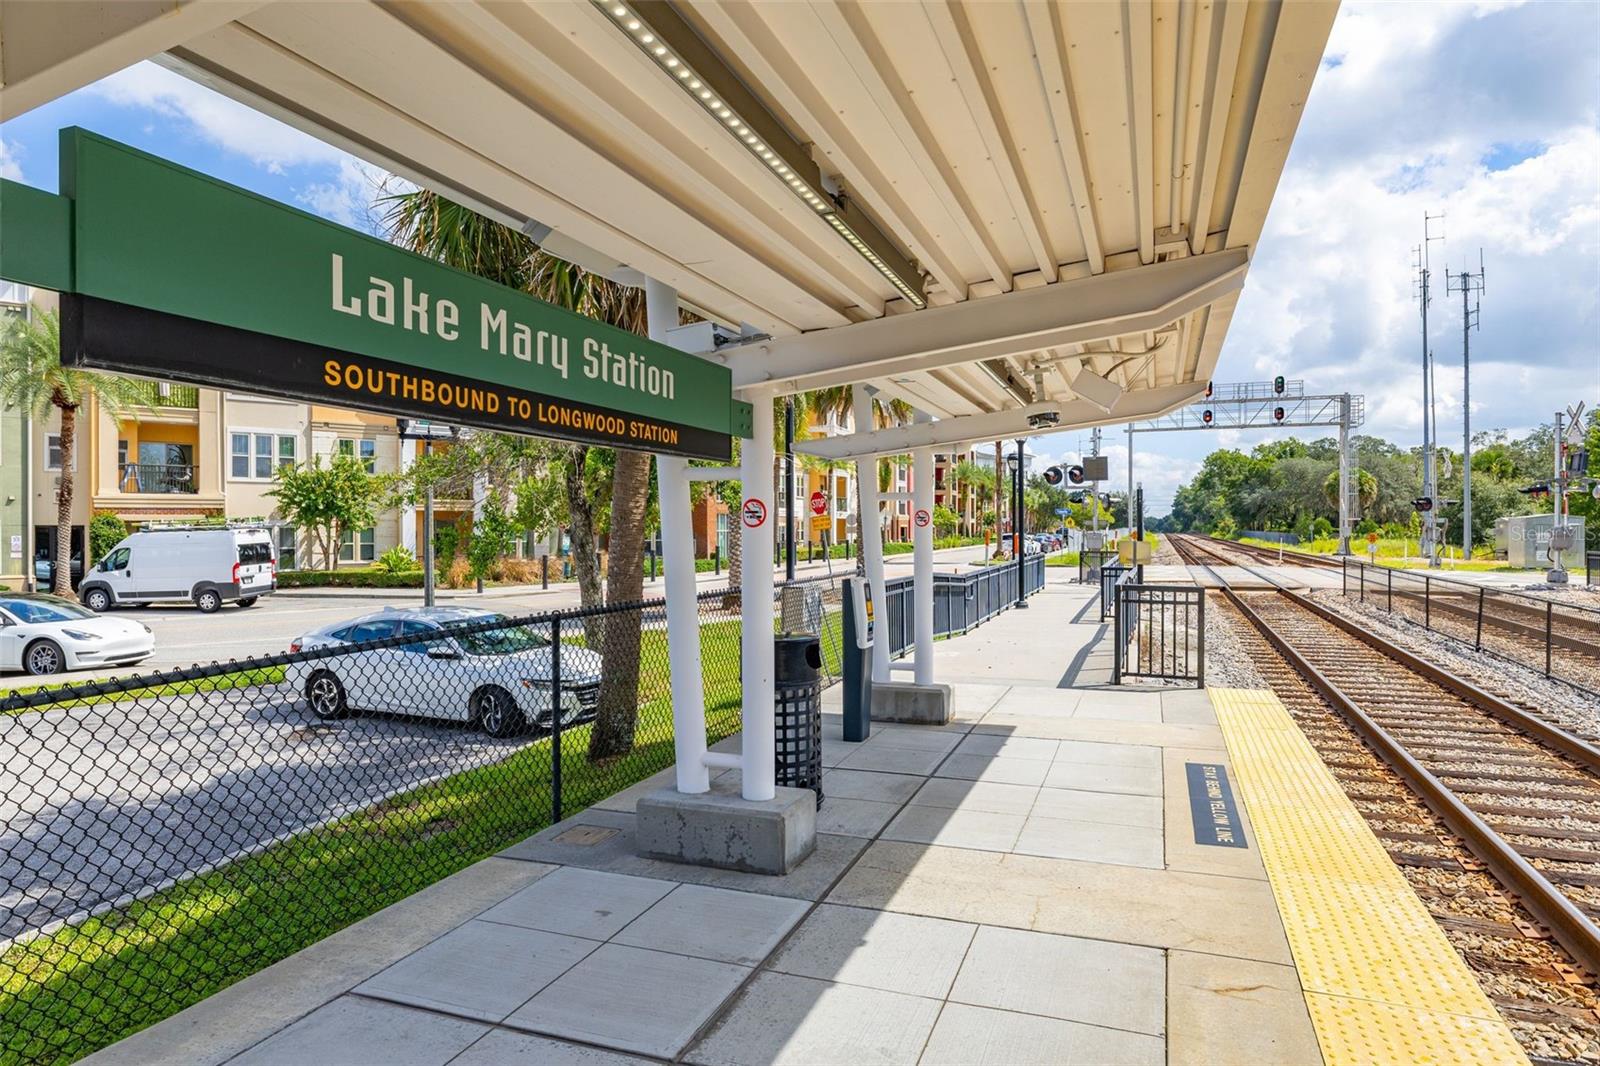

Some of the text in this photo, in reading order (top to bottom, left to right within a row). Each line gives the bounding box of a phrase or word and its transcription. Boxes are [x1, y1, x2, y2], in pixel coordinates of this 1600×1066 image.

[332, 253, 675, 400] Lake Mary Station
[323, 360, 678, 445] SOUTHBOUND TO LONGWOOD STATION
[811, 498, 826, 509] STOP
[1202, 766, 1234, 843] STAY BEHIND YELLOW LINE
